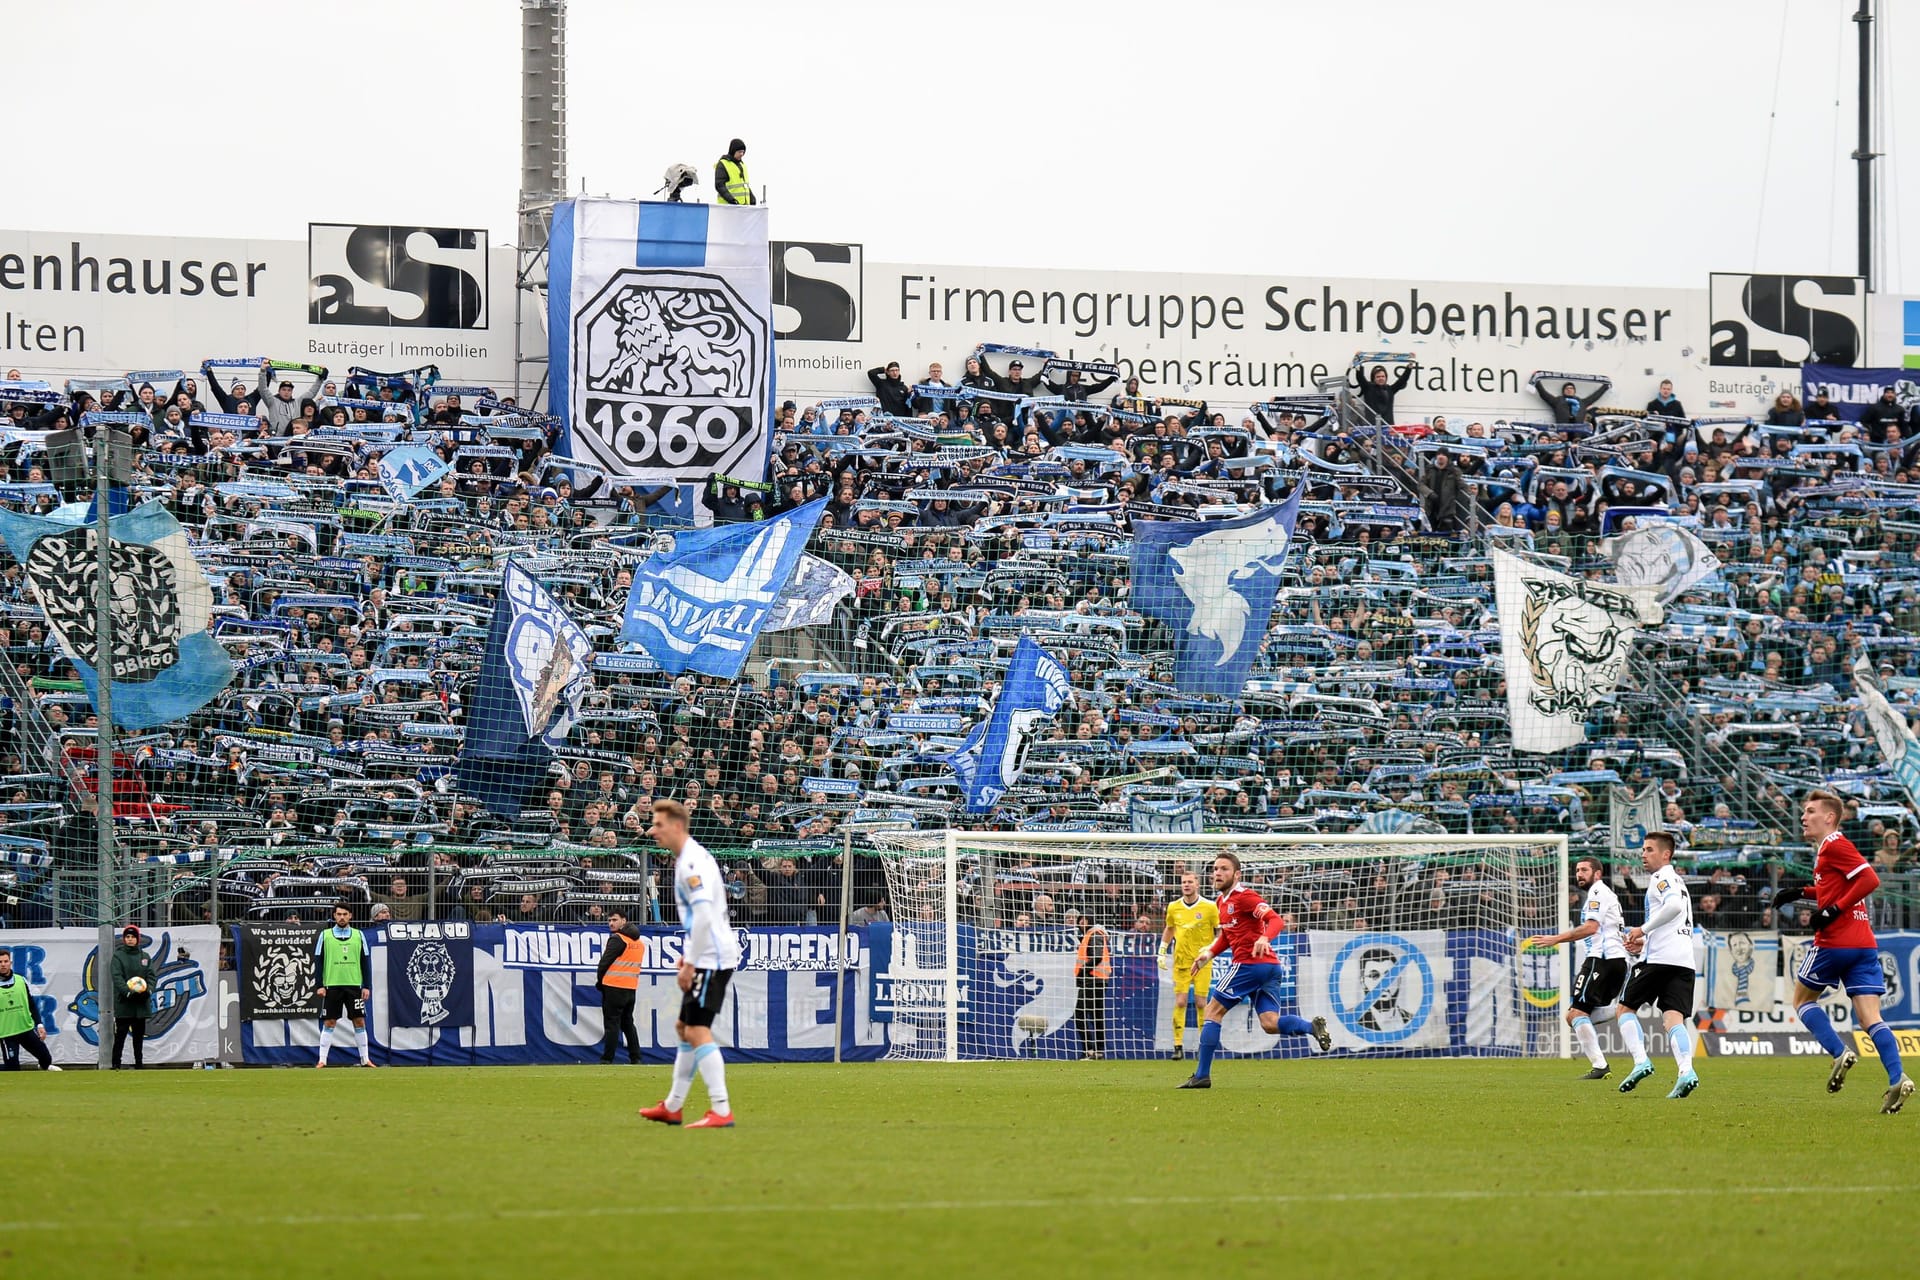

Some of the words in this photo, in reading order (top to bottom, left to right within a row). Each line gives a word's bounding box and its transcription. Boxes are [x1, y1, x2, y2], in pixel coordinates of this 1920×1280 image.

[901, 275, 1245, 338] Firmengruppe
[1265, 285, 1671, 342] Schrobenhauser
[308, 338, 385, 358] Bauträger
[400, 341, 488, 358] Immobilien
[779, 354, 862, 371] Immobilien
[203, 416, 247, 427] SECHZGER
[593, 402, 739, 466] 1860
[609, 660, 655, 670] SECHZGER
[903, 720, 948, 730] SECHZGER
[257, 749, 297, 760] SECHZIG
[317, 756, 364, 774] MÜNCHEN
[163, 831, 176, 839] VON
[268, 927, 286, 936] will
[287, 928, 317, 937] never
[261, 936, 272, 945] be
[273, 936, 312, 945] divided
[755, 956, 793, 971] steht
[795, 958, 824, 971] zum
[1719, 1036, 1774, 1055] bwin
